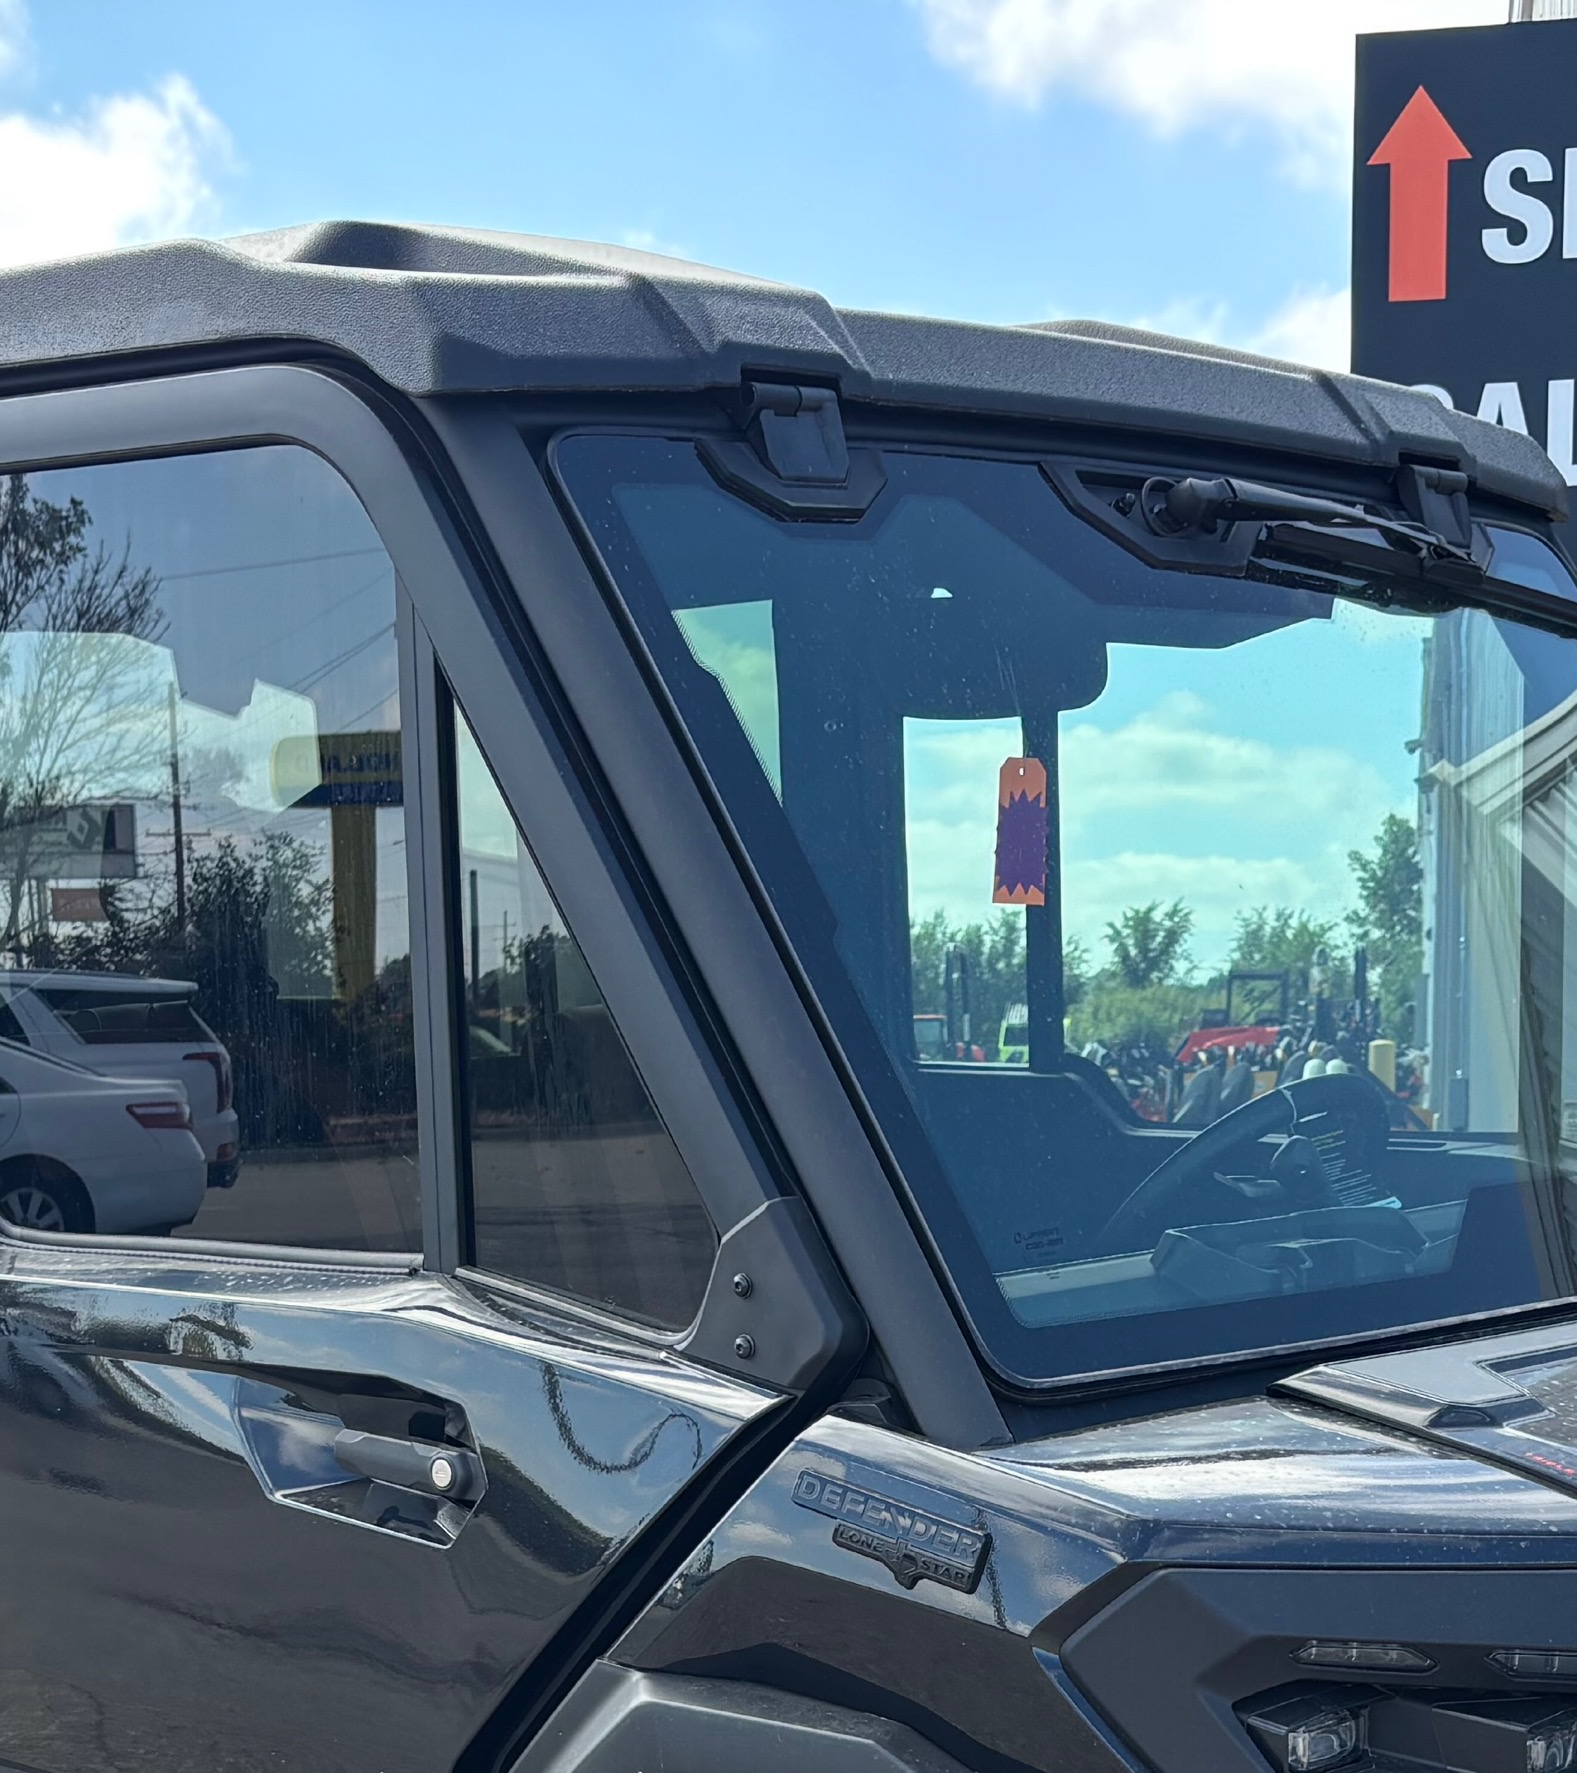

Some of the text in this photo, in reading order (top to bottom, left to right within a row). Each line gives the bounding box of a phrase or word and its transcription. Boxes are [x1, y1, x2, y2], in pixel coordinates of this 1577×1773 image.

[796, 1475, 982, 1560] DEFENDER
[837, 1525, 968, 1585] LONE STAR
